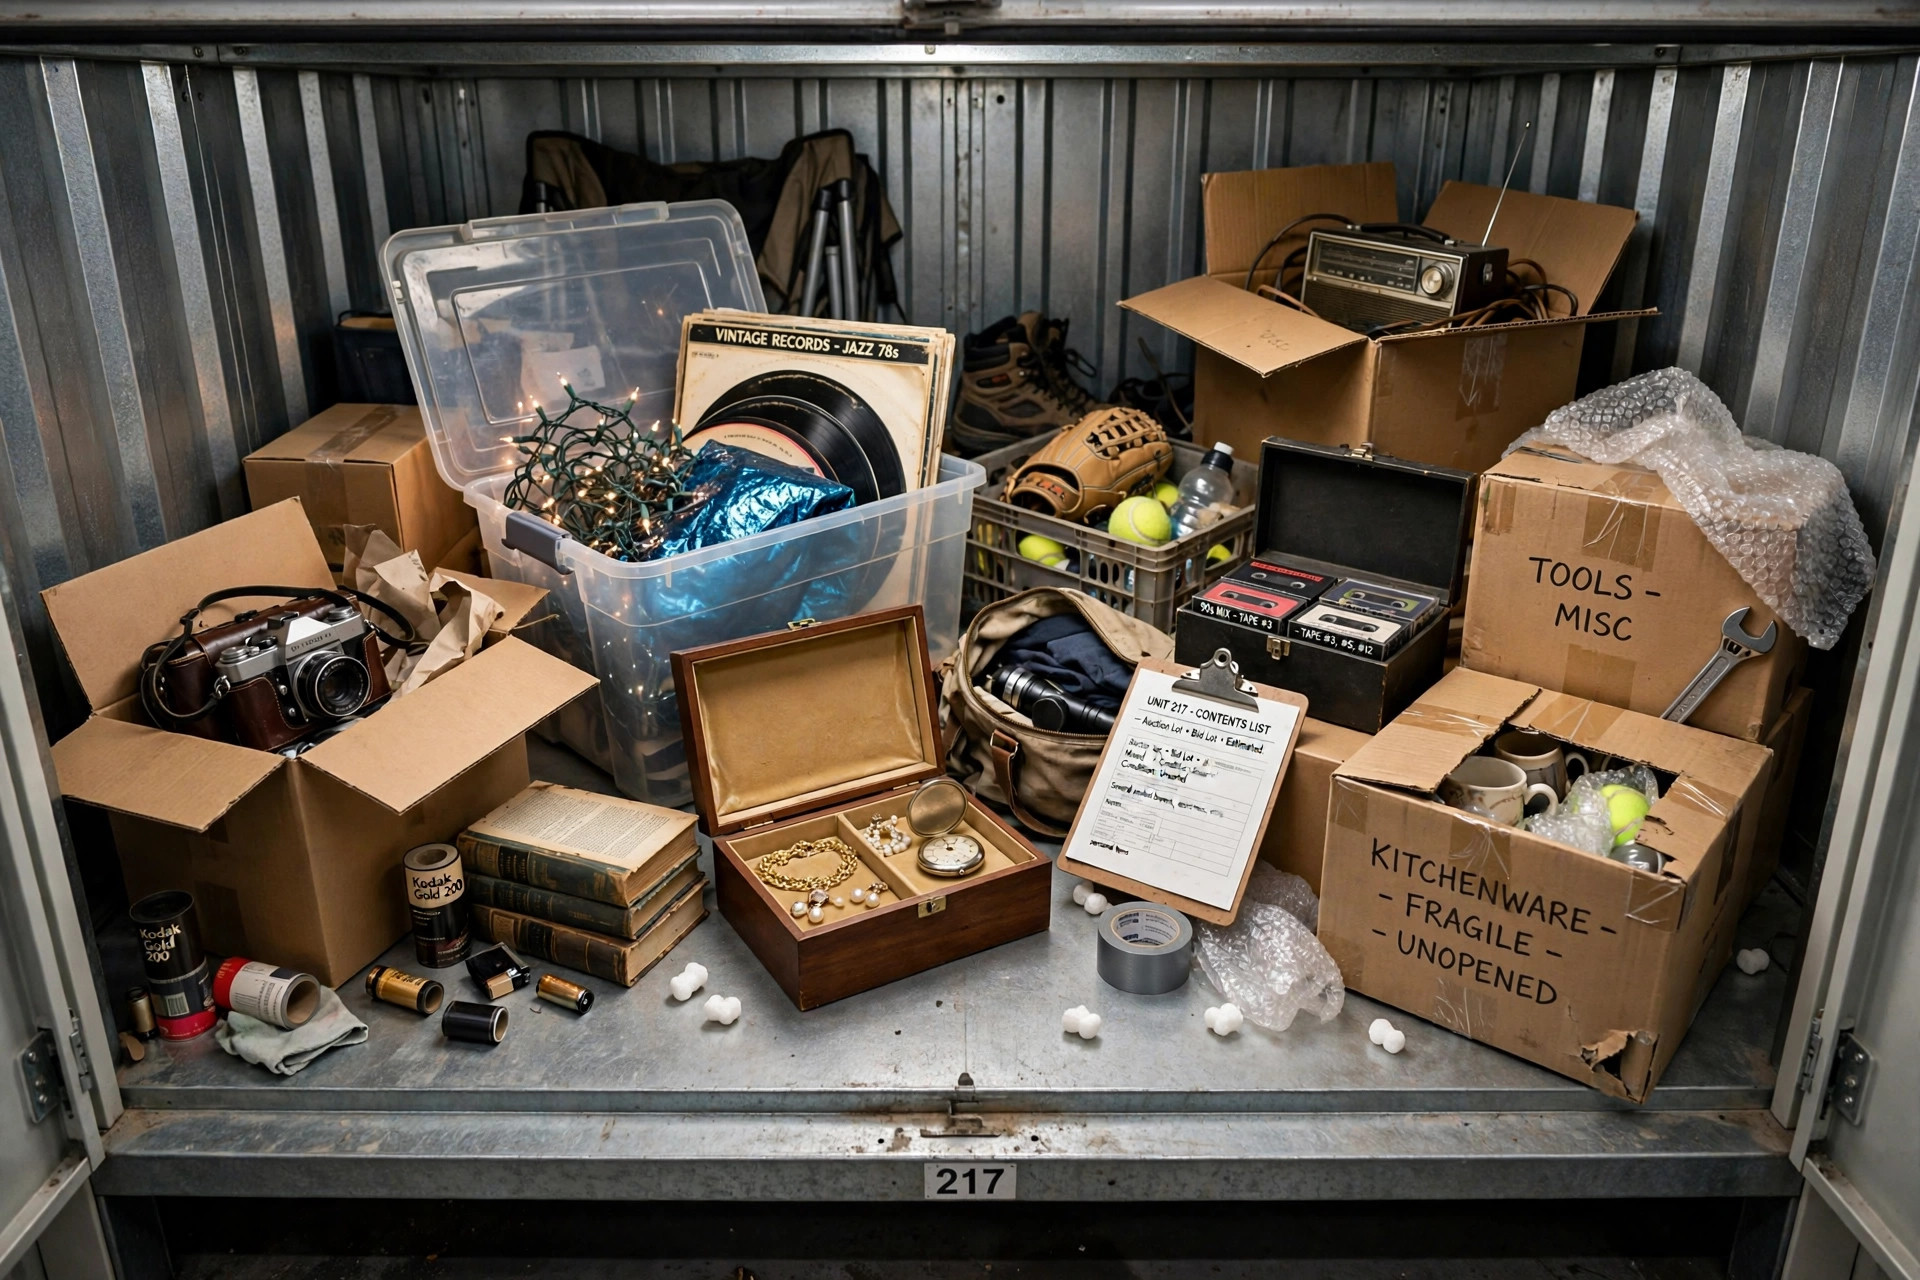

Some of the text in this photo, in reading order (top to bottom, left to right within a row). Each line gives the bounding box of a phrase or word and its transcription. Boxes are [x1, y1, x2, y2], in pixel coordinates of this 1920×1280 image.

[715, 328, 768, 345] VINTAGE
[772, 333, 831, 352] RECORDS
[842, 340, 874, 356] JAZZ
[878, 344, 899, 359] 78s
[1528, 556, 1632, 600] TOOLS
[1200, 602, 1214, 615] 90s
[1216, 606, 1231, 619] MIX
[1239, 612, 1259, 626] TAPE
[1555, 603, 1632, 641] MISC
[1301, 627, 1322, 641] TAPE
[1147, 696, 1170, 710] UNIT
[1171, 701, 1188, 715] 217
[1195, 708, 1247, 729] CONTENTS
[1249, 721, 1271, 735] LIST
[1142, 716, 1170, 730] Auction
[1171, 723, 1183, 734] Lot
[1191, 728, 1205, 739] Bid
[1205, 732, 1218, 743] Lot
[412, 873, 452, 888] Kodak
[414, 879, 462, 900] Gold 200
[1371, 837, 1591, 935] KITCHENWARE
[140, 924, 181, 939] Kodak
[1406, 892, 1534, 957] FRAGILE
[144, 934, 176, 951] Gold
[146, 951, 170, 962] 200
[1397, 930, 1557, 1005] UNOPENED
[936, 1167, 1005, 1195] 217
